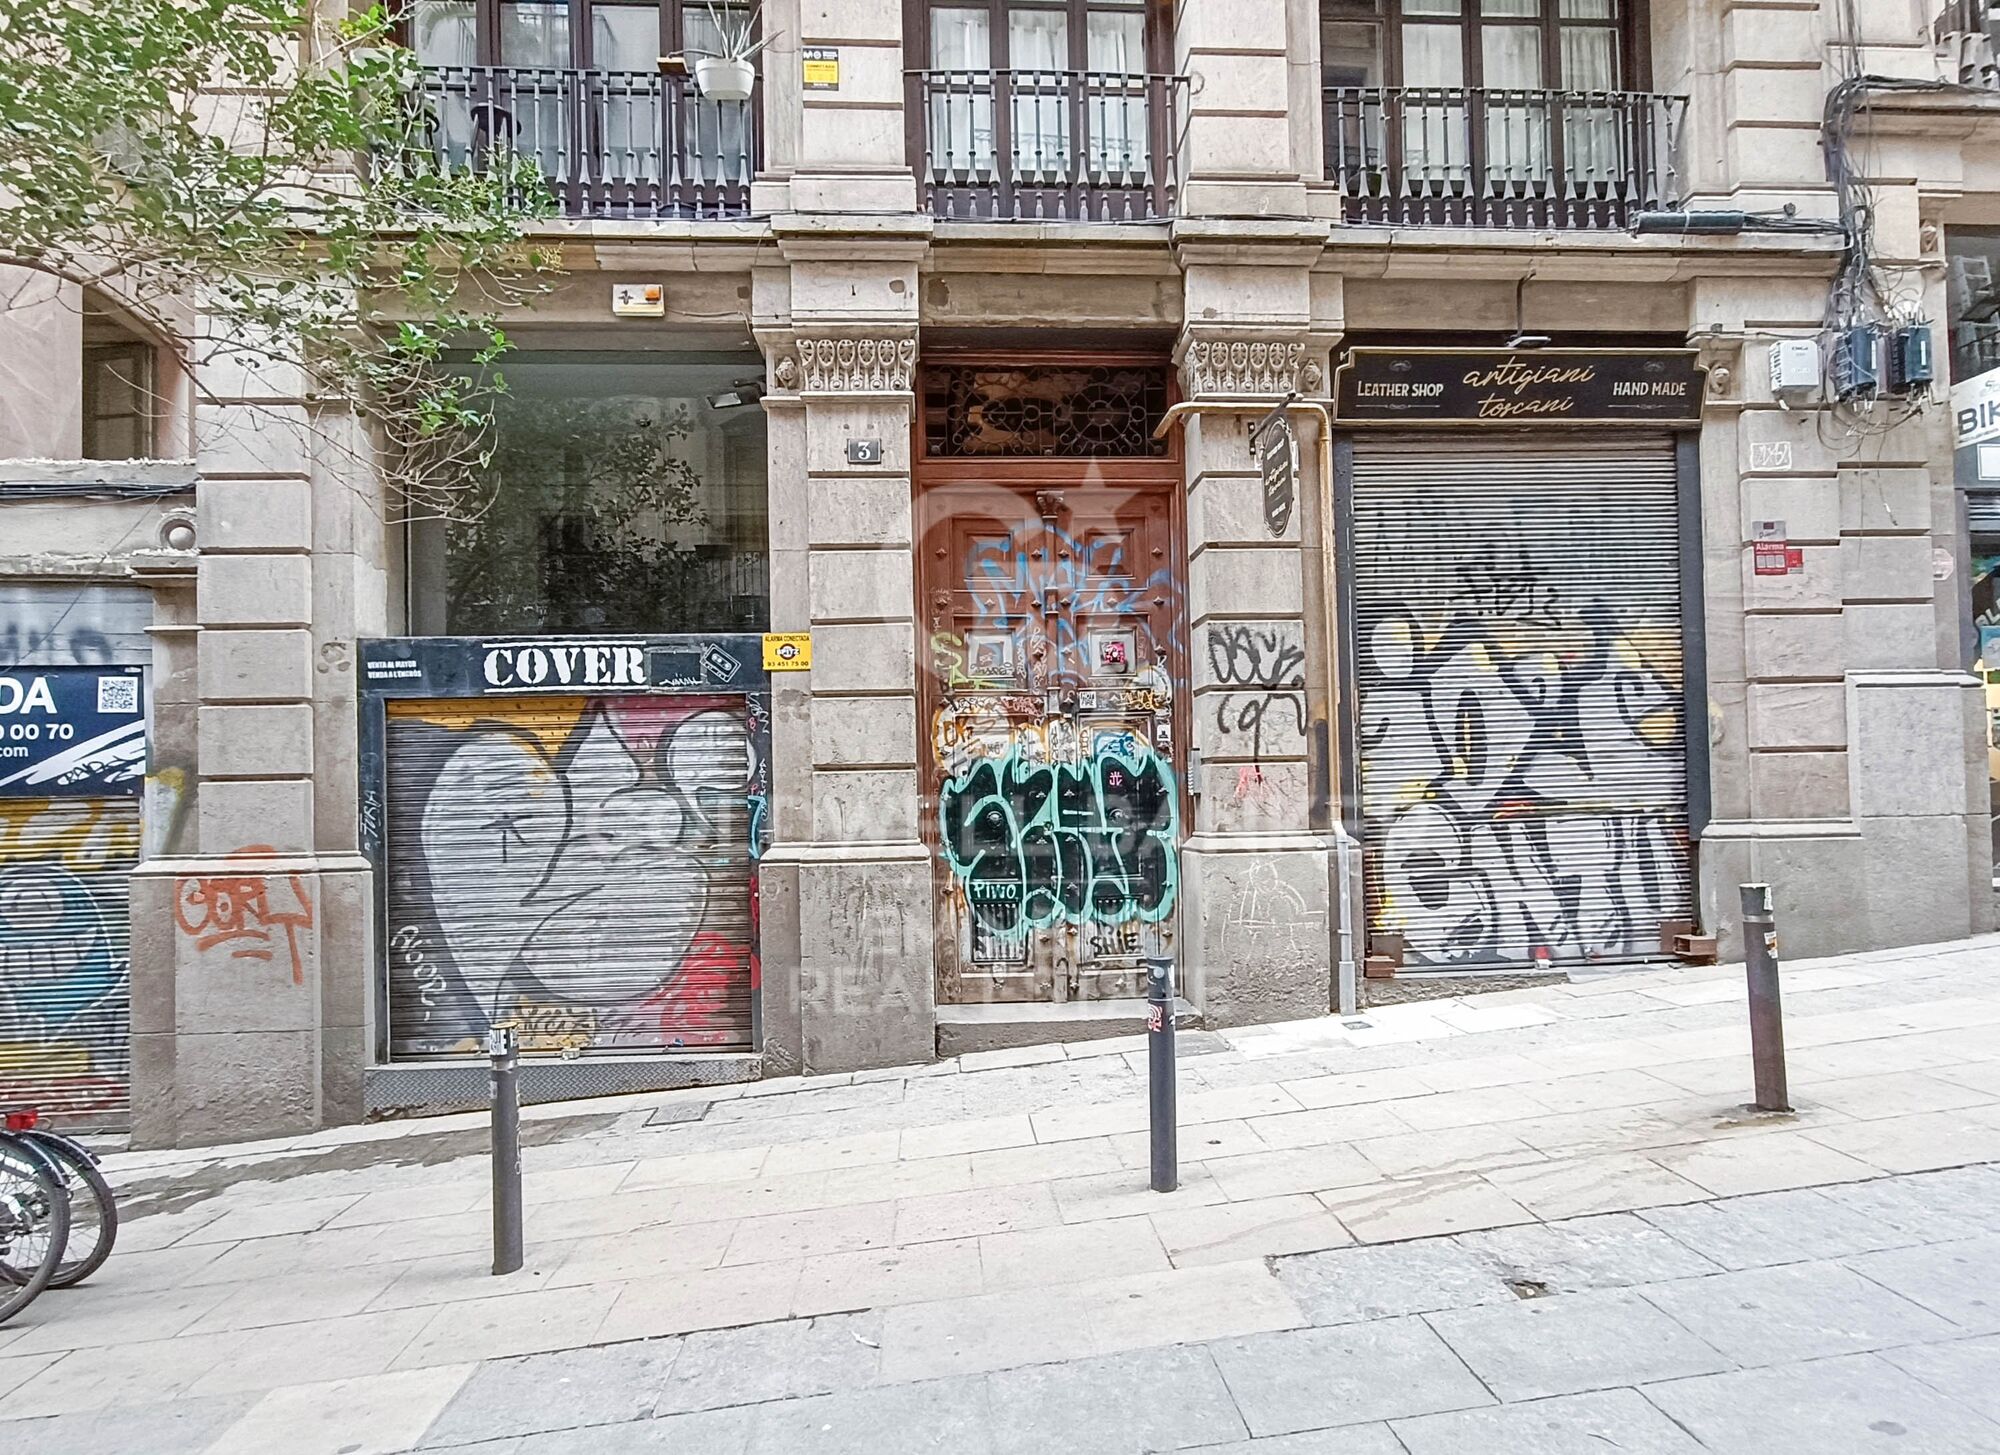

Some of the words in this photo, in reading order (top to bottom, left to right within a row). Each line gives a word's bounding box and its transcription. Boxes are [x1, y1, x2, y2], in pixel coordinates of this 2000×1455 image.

[1462, 356, 1597, 396] artigiani
[1357, 380, 1410, 397] LEATHER
[1411, 383, 1444, 398] SHOP
[1612, 381, 1650, 397] HAND
[1651, 381, 1687, 396] MADE
[1476, 392, 1575, 419] toscani
[857, 441, 871, 460] 3
[483, 648, 647, 686] COVER
[10, 723, 39, 740] 00
[45, 723, 74, 740] 70
